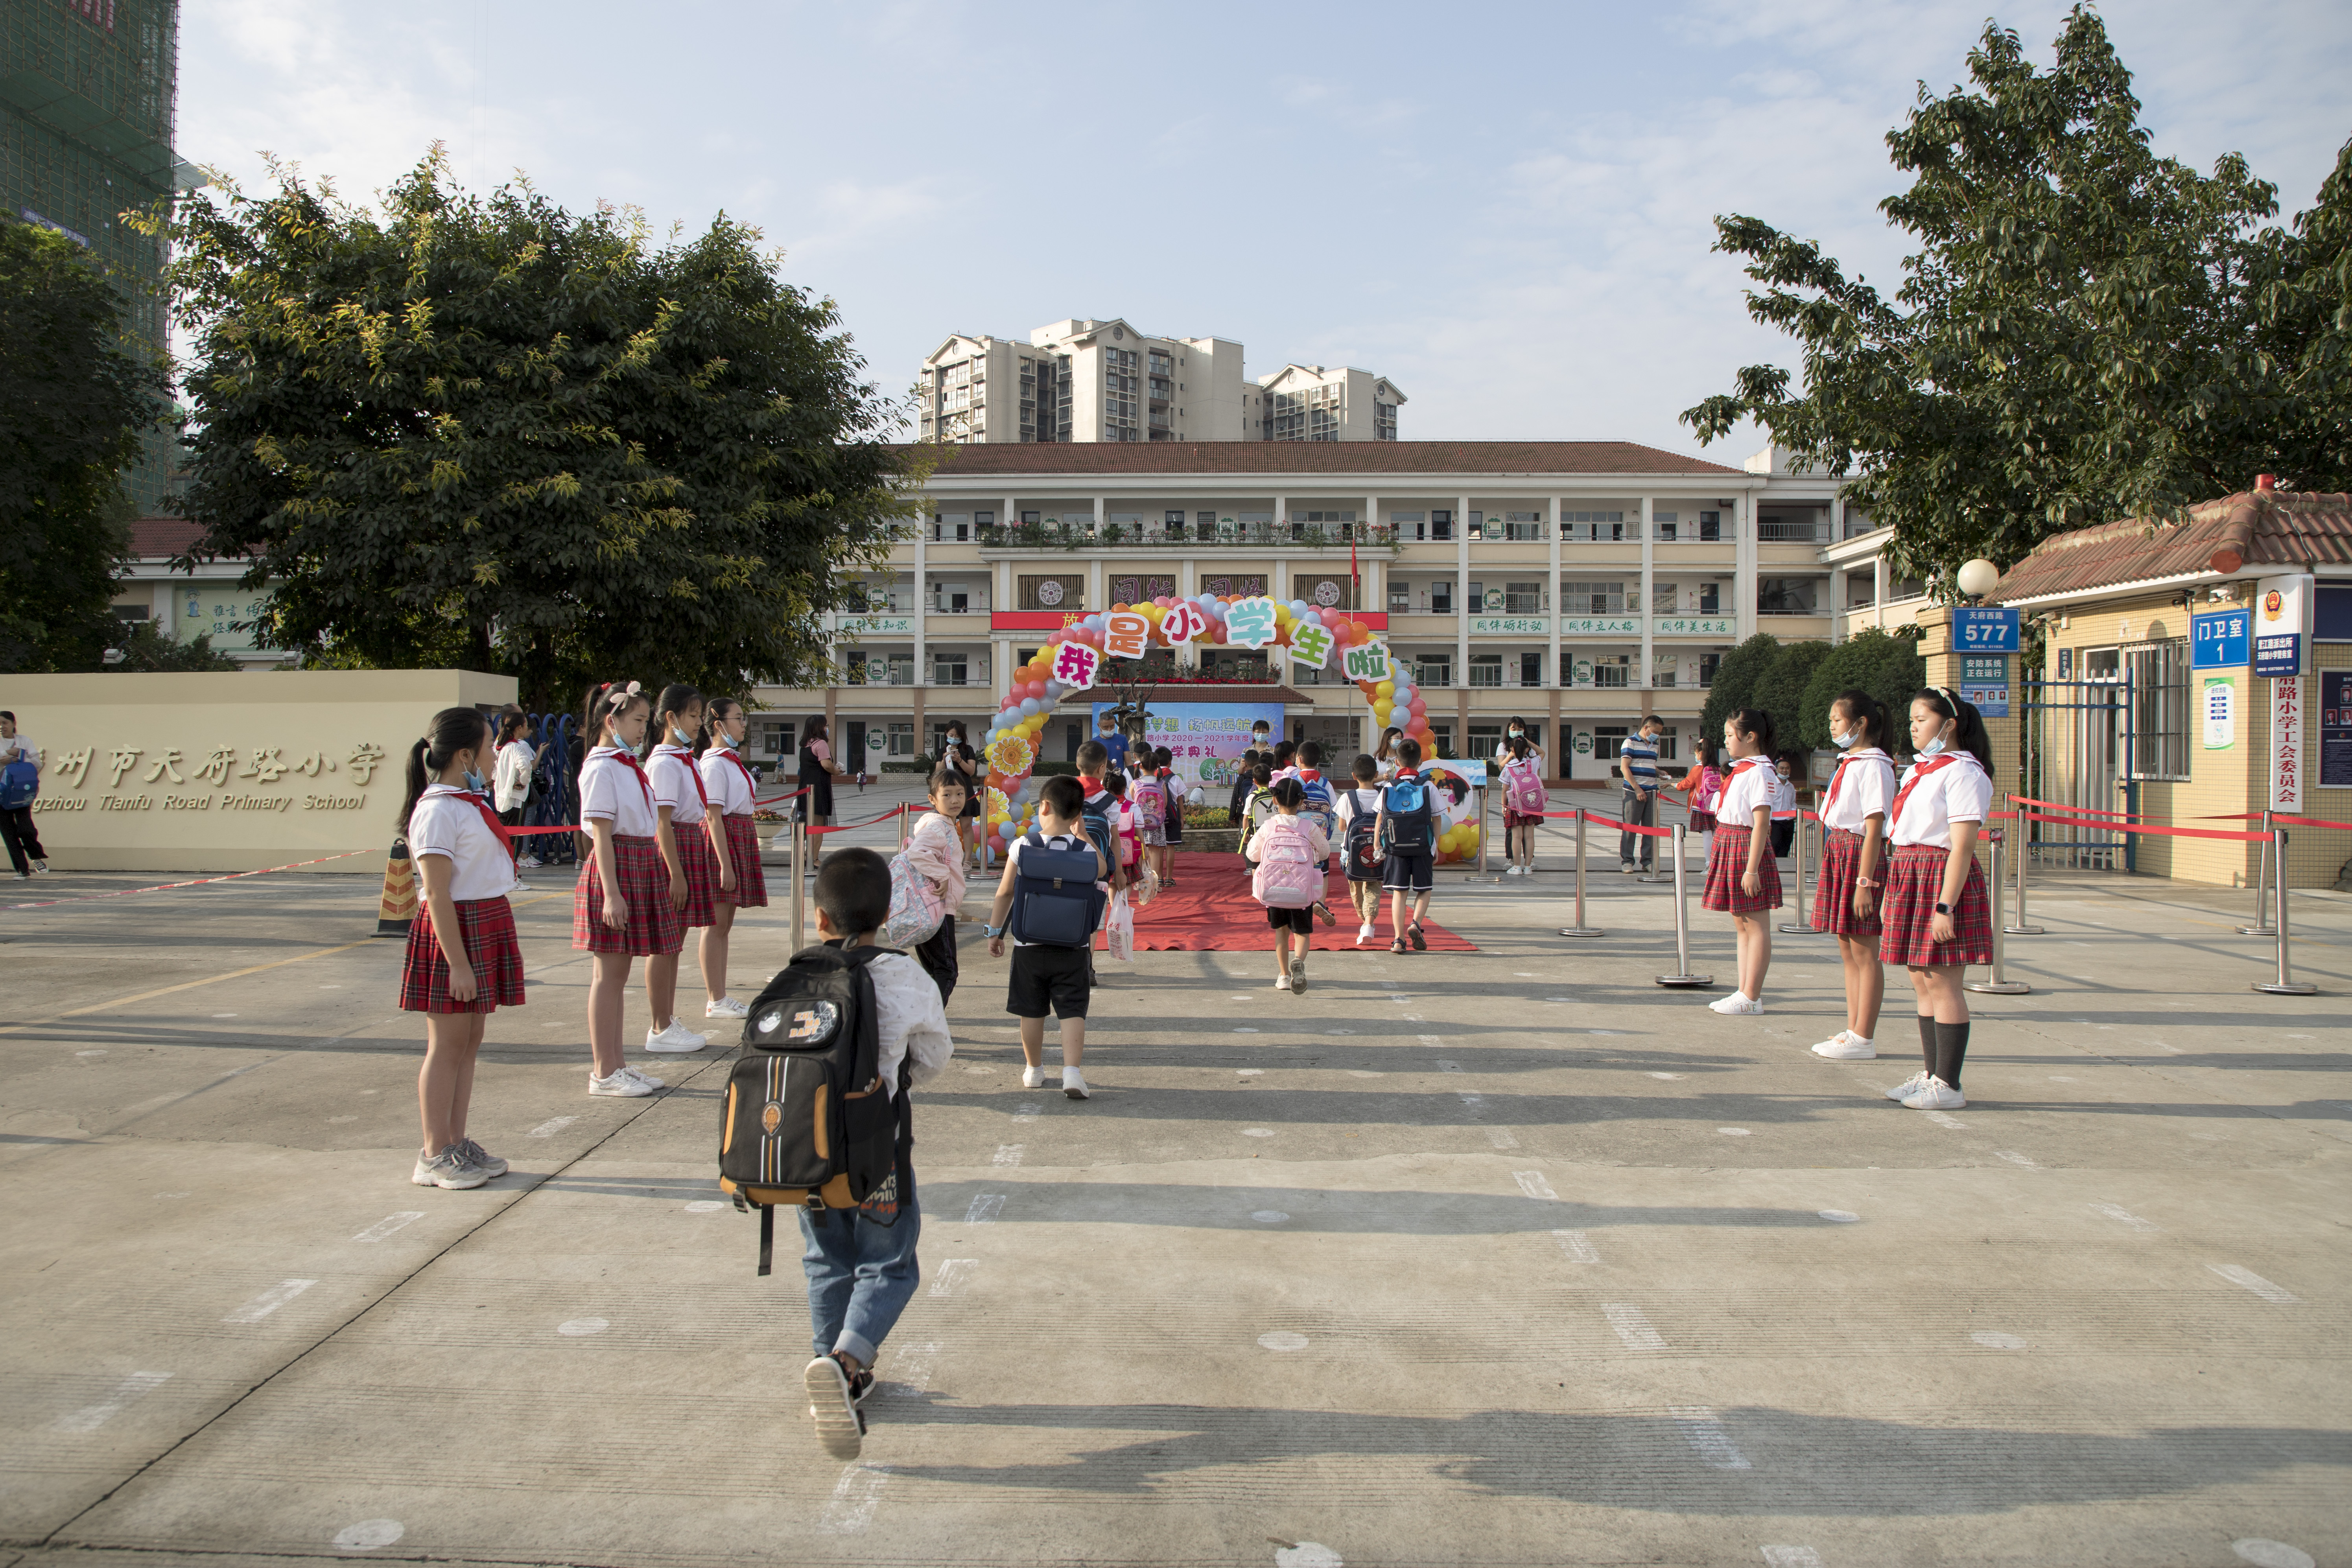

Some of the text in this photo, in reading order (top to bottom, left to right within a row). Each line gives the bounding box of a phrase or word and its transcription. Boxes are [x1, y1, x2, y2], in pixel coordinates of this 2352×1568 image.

[1063, 613, 1078, 628] 放
[1969, 611, 2004, 619] 天府西路
[1477, 620, 1542, 632] 同伴砺行动
[1569, 620, 1634, 632] 同伴立人格
[1662, 620, 1726, 632] 同伴美生活
[2199, 618, 2243, 641] 门卫室
[1965, 625, 2009, 641] 577
[2217, 643, 2223, 661] 1
[1188, 718, 1252, 732] 扬帆远航
[1156, 745, 1217, 757] 学典礼
[38, 743, 385, 788] 州市天府路小学
[31, 793, 366, 813] gzhou Tianfu Road Primary School
[794, 1010, 815, 1021] ZHI
[804, 1018, 820, 1028] MA
[789, 1026, 818, 1038] BABY
